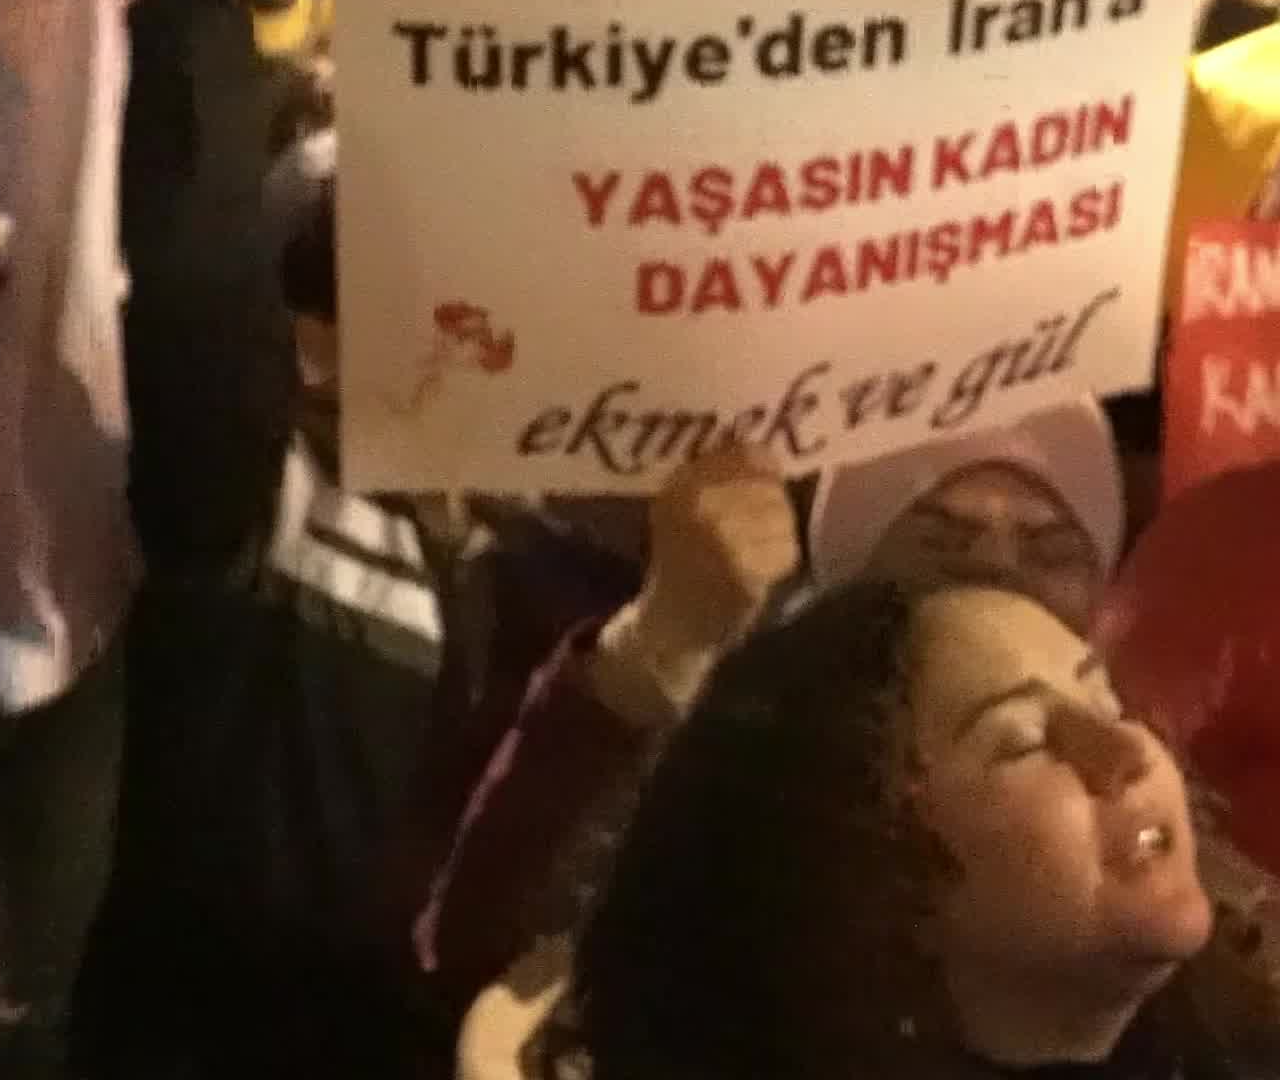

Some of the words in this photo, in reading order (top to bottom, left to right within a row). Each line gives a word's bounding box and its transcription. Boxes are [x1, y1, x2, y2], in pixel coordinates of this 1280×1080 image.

[392, 7, 908, 103] Türkiye'den
[572, 141, 914, 233] YAŞASIN
[930, 93, 1136, 192] KADIN
[635, 180, 1125, 317] DAYANIŞMASI
[518, 359, 833, 475] ekmek
[839, 361, 936, 431] ve
[928, 284, 1122, 431] gül
